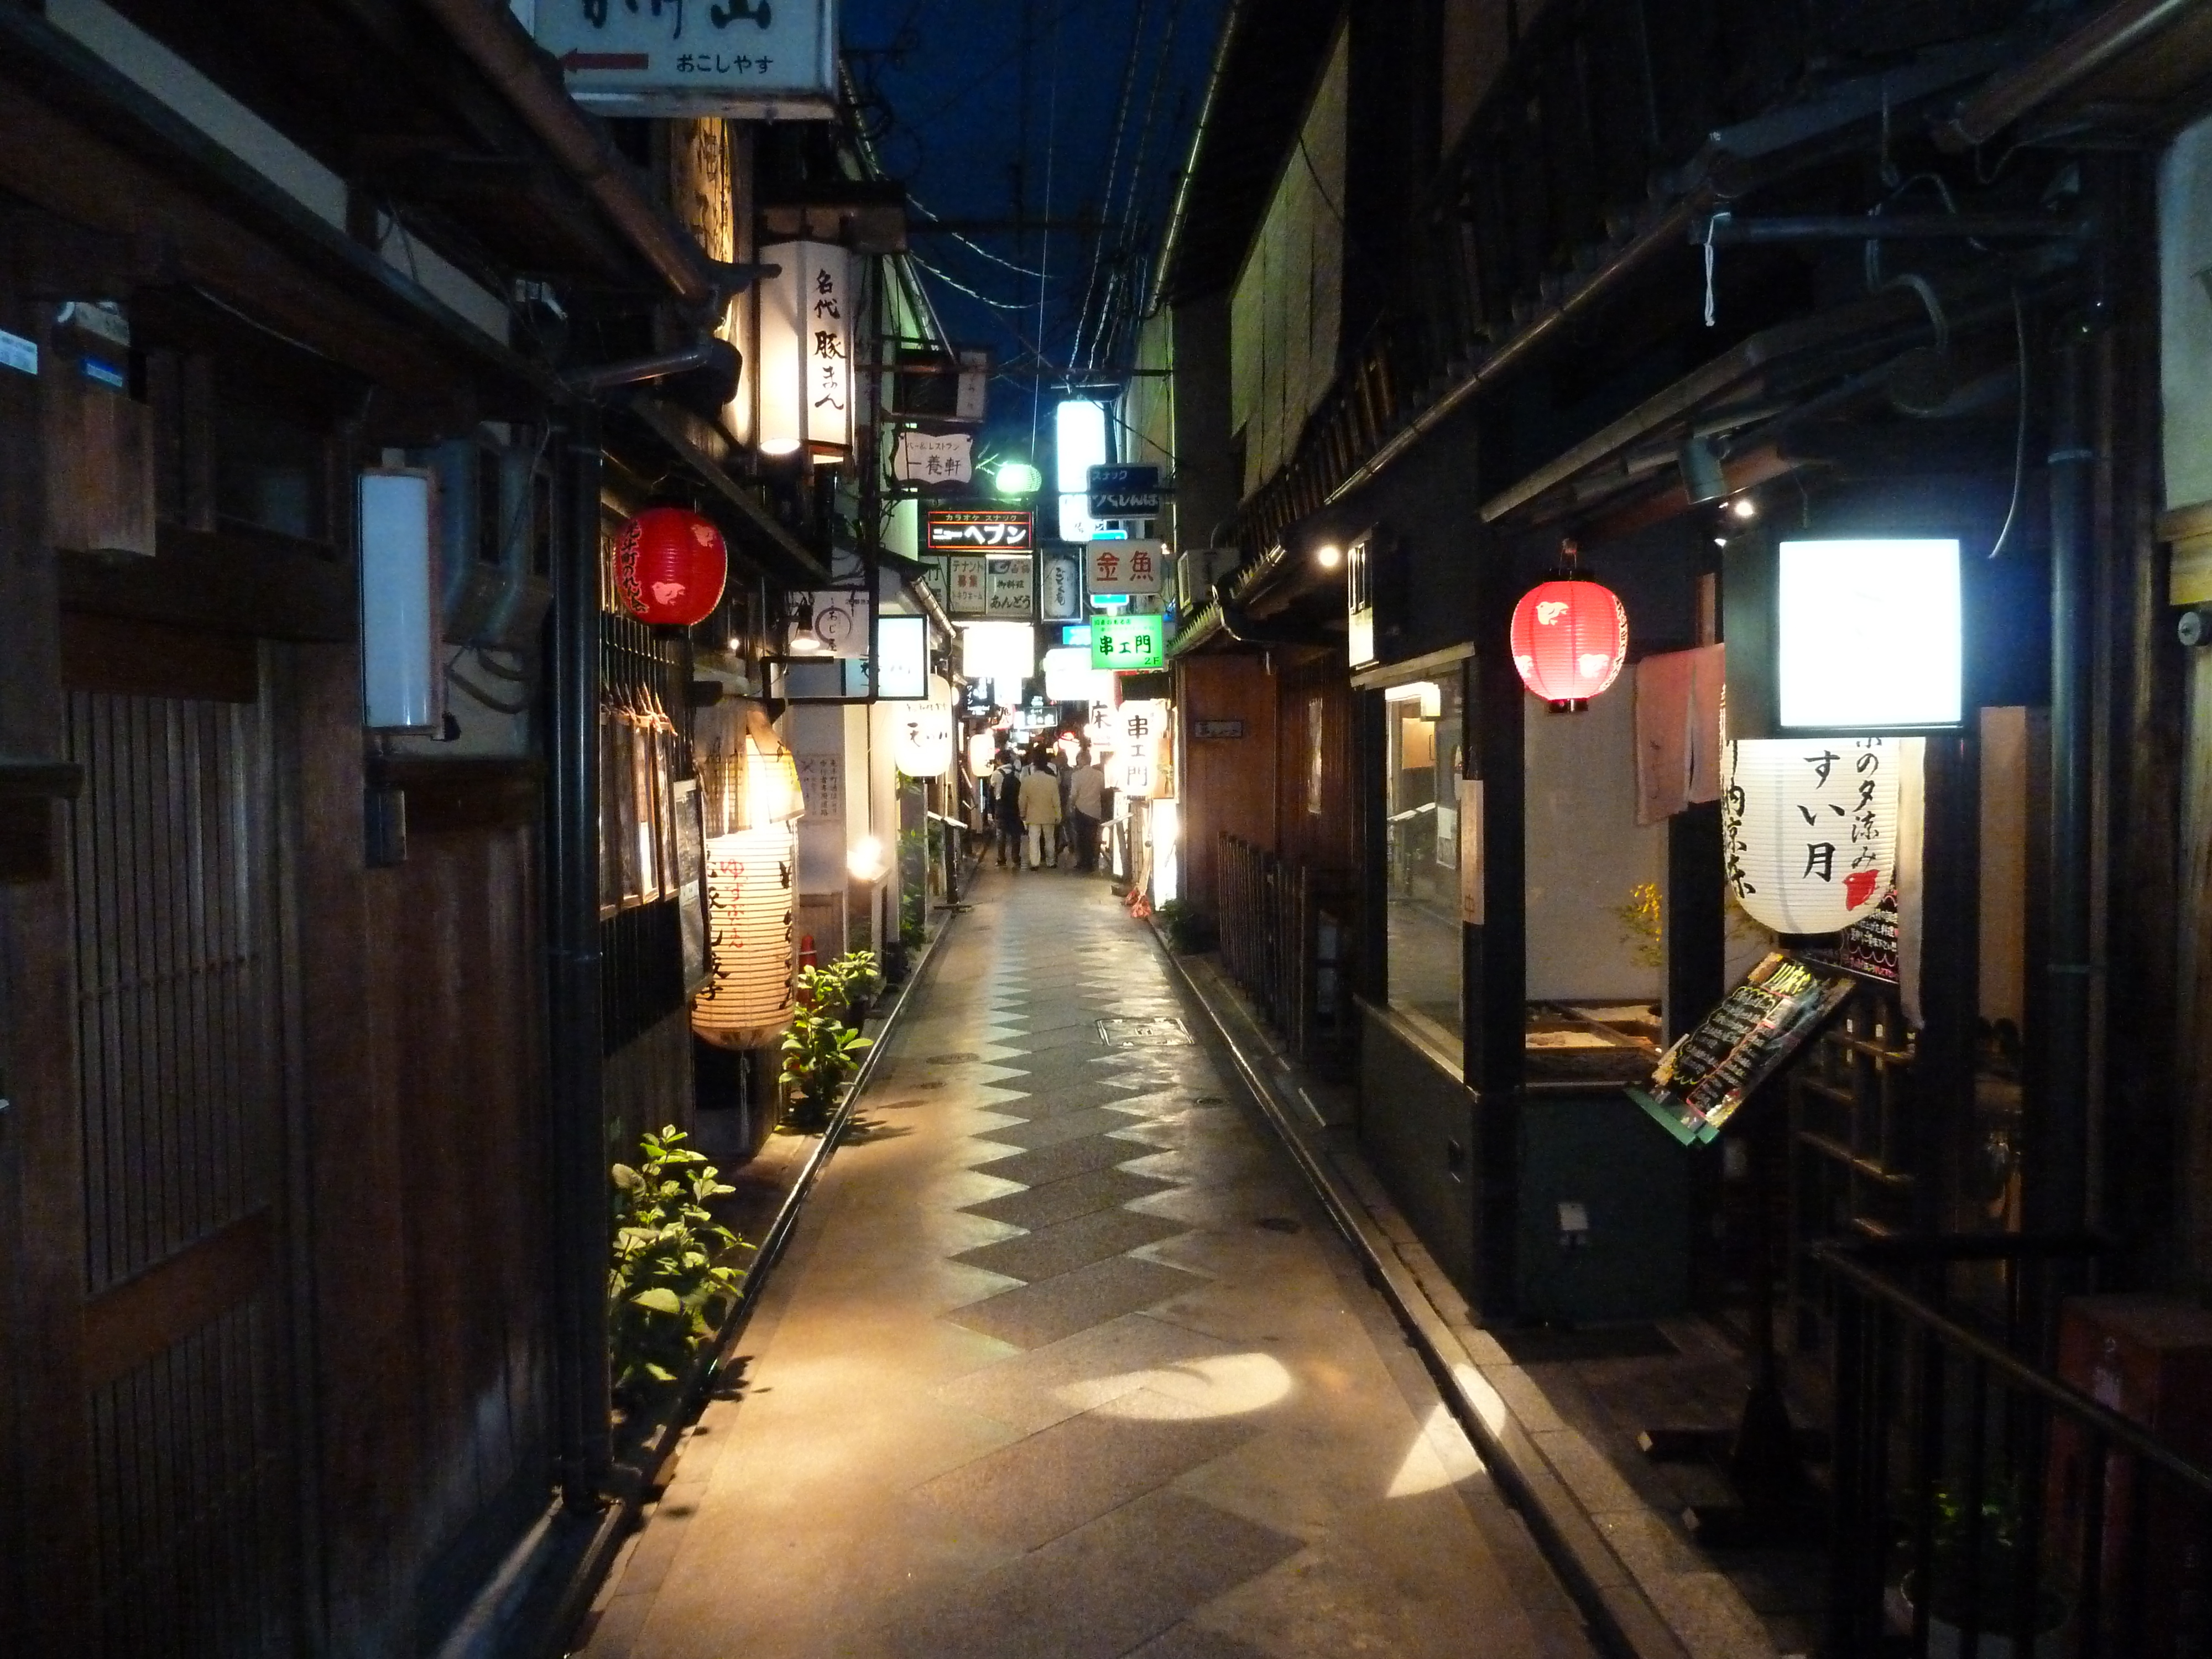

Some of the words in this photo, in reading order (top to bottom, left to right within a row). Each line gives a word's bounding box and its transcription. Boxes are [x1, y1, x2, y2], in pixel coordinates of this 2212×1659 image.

[677, 54, 773, 74] おこしやす
[909, 455, 961, 476] 一養軒
[952, 560, 984, 572] テナント
[1097, 550, 1154, 582] 金魚
[1145, 656, 1160, 665] 2F
[1797, 749, 1846, 883] すい月
